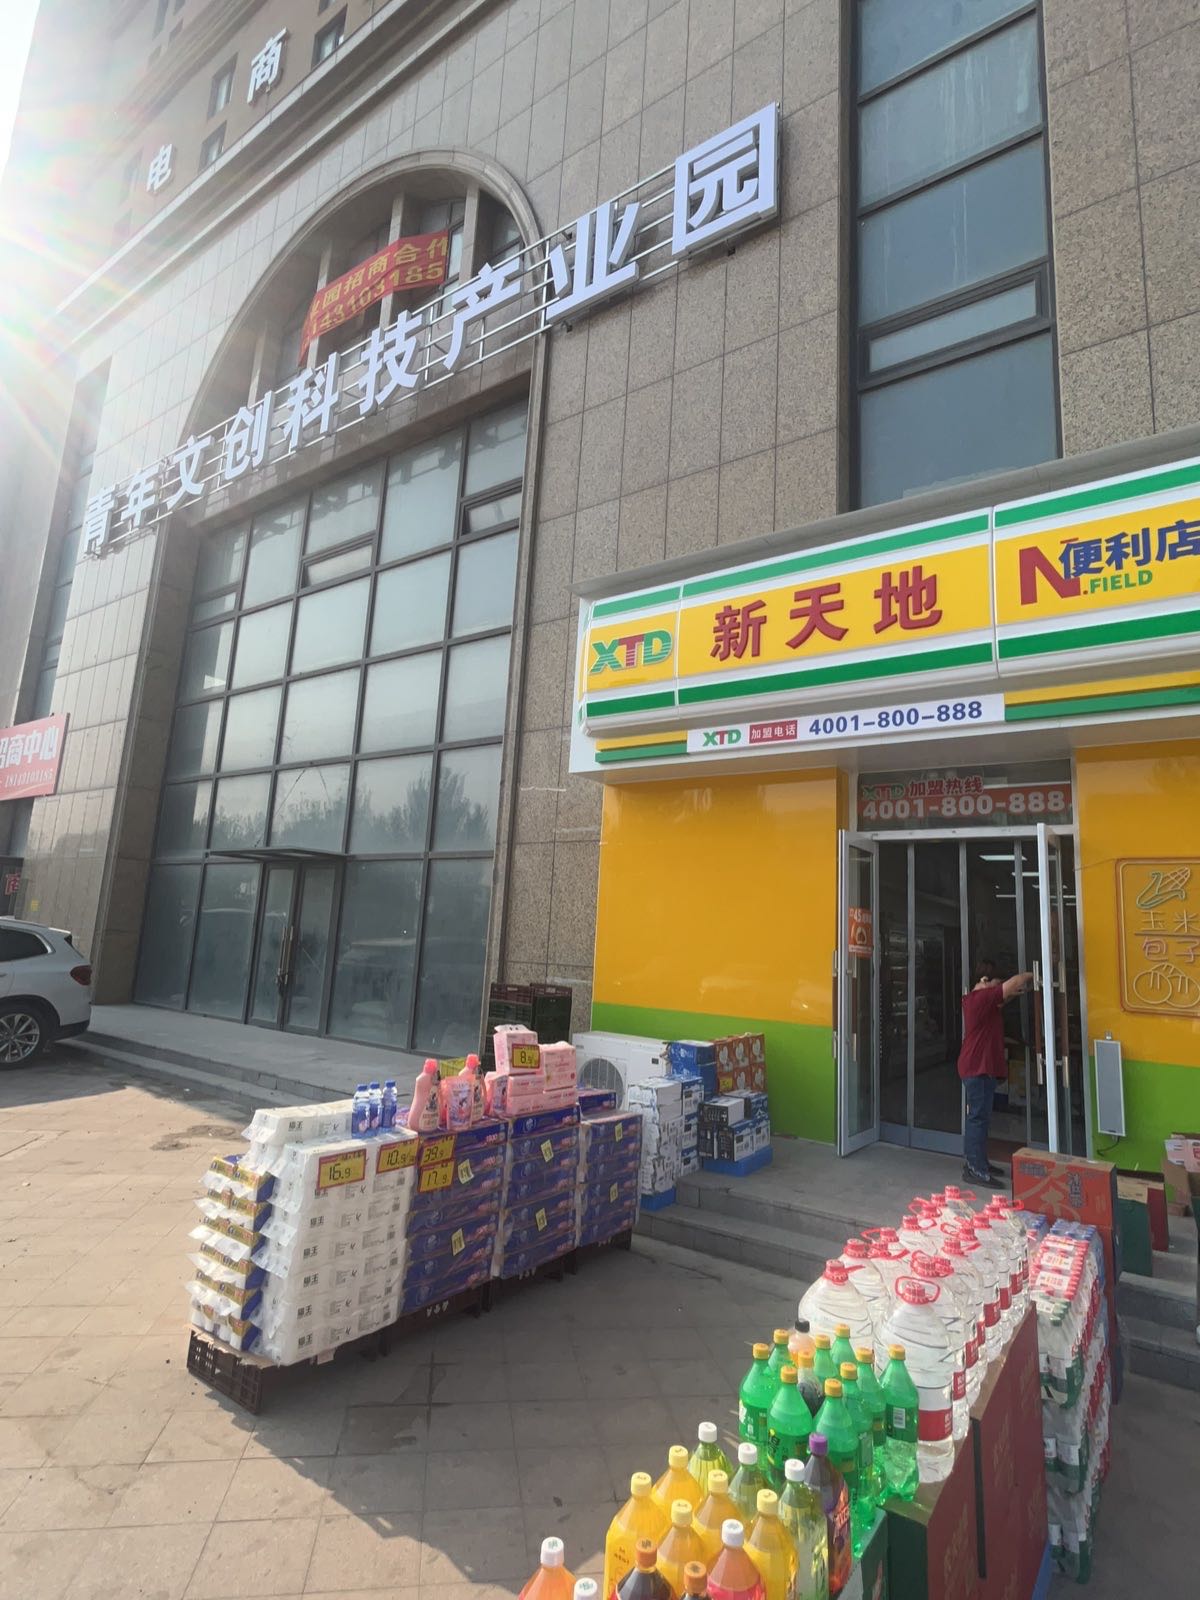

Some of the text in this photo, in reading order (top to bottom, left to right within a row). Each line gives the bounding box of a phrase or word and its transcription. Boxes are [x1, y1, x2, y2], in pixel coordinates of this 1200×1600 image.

[84, 102, 776, 548] 青年文创科技产业园
[1058, 518, 1200, 580] 便利店
[710, 565, 943, 661] 新天地
[588, 629, 672, 674] XTD
[703, 701, 983, 747] XTD 加盟电话 4001-800-888
[862, 775, 984, 801] XTD 加盟热线
[862, 790, 1066, 821] 4001-800-888
[1140, 909, 1200, 934] 玉米
[1142, 936, 1200, 963] 包子
